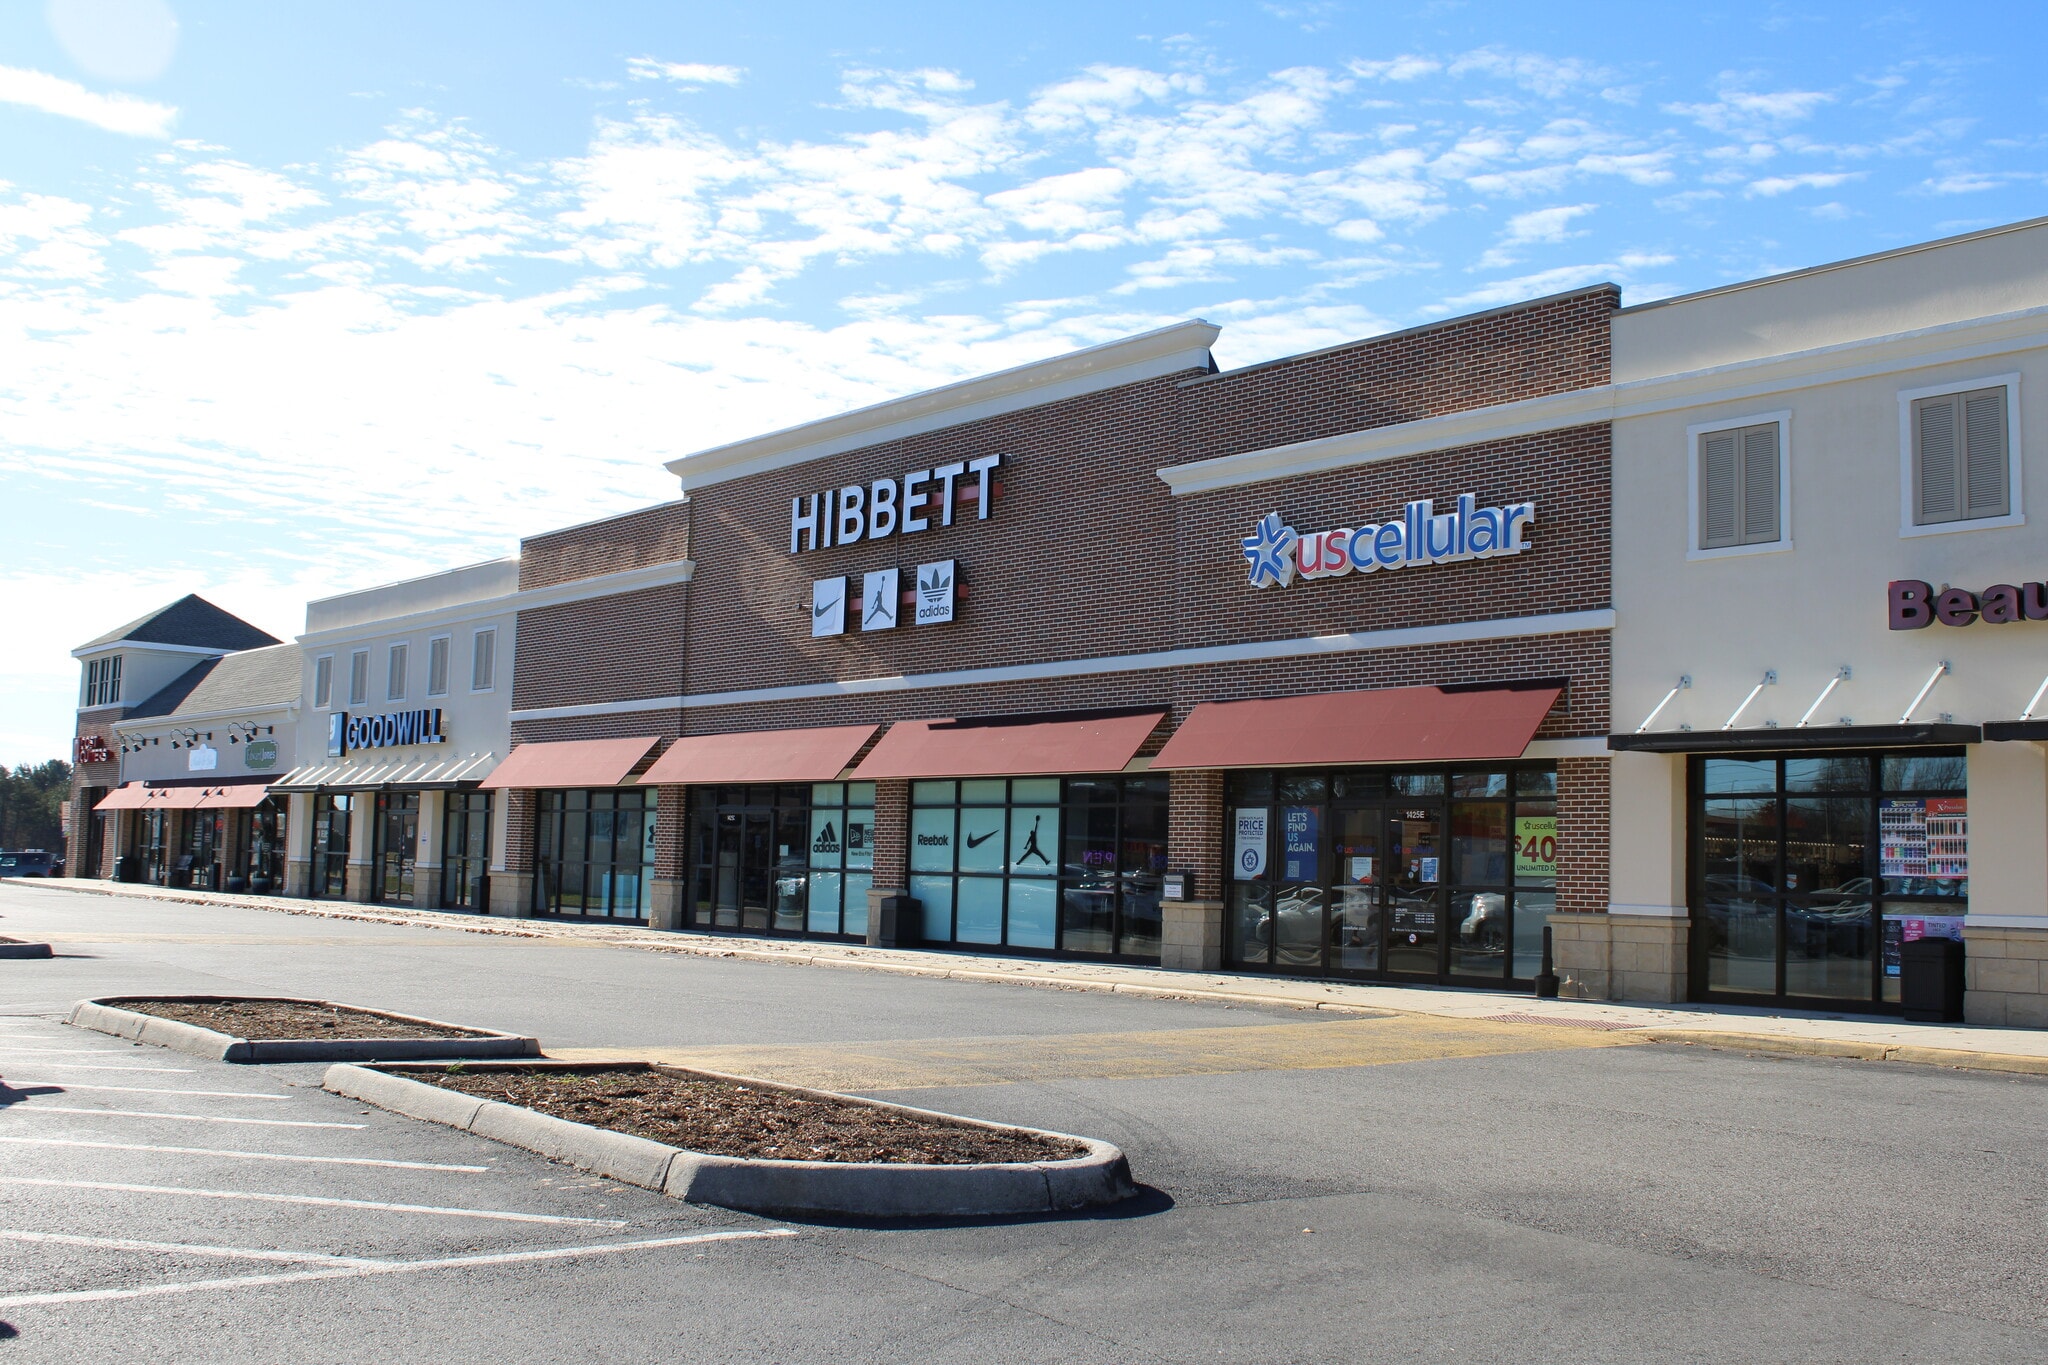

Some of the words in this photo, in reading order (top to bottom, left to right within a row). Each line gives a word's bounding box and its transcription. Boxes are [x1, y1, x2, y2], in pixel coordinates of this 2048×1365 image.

[790, 454, 1002, 554] HIBBETT
[1296, 494, 1532, 577] uscellular
[1888, 580, 2048, 630] Beau
[919, 605, 950, 619] adidas
[346, 709, 444, 751] GOODWILL
[1287, 813, 1307, 822] LET'S
[1239, 820, 1264, 830] PRICE
[1287, 823, 1307, 832] FIND
[917, 834, 949, 846] Reebok
[1287, 833, 1299, 842] US
[813, 841, 840, 853] adidas
[1287, 843, 1315, 852] AGAIN.
